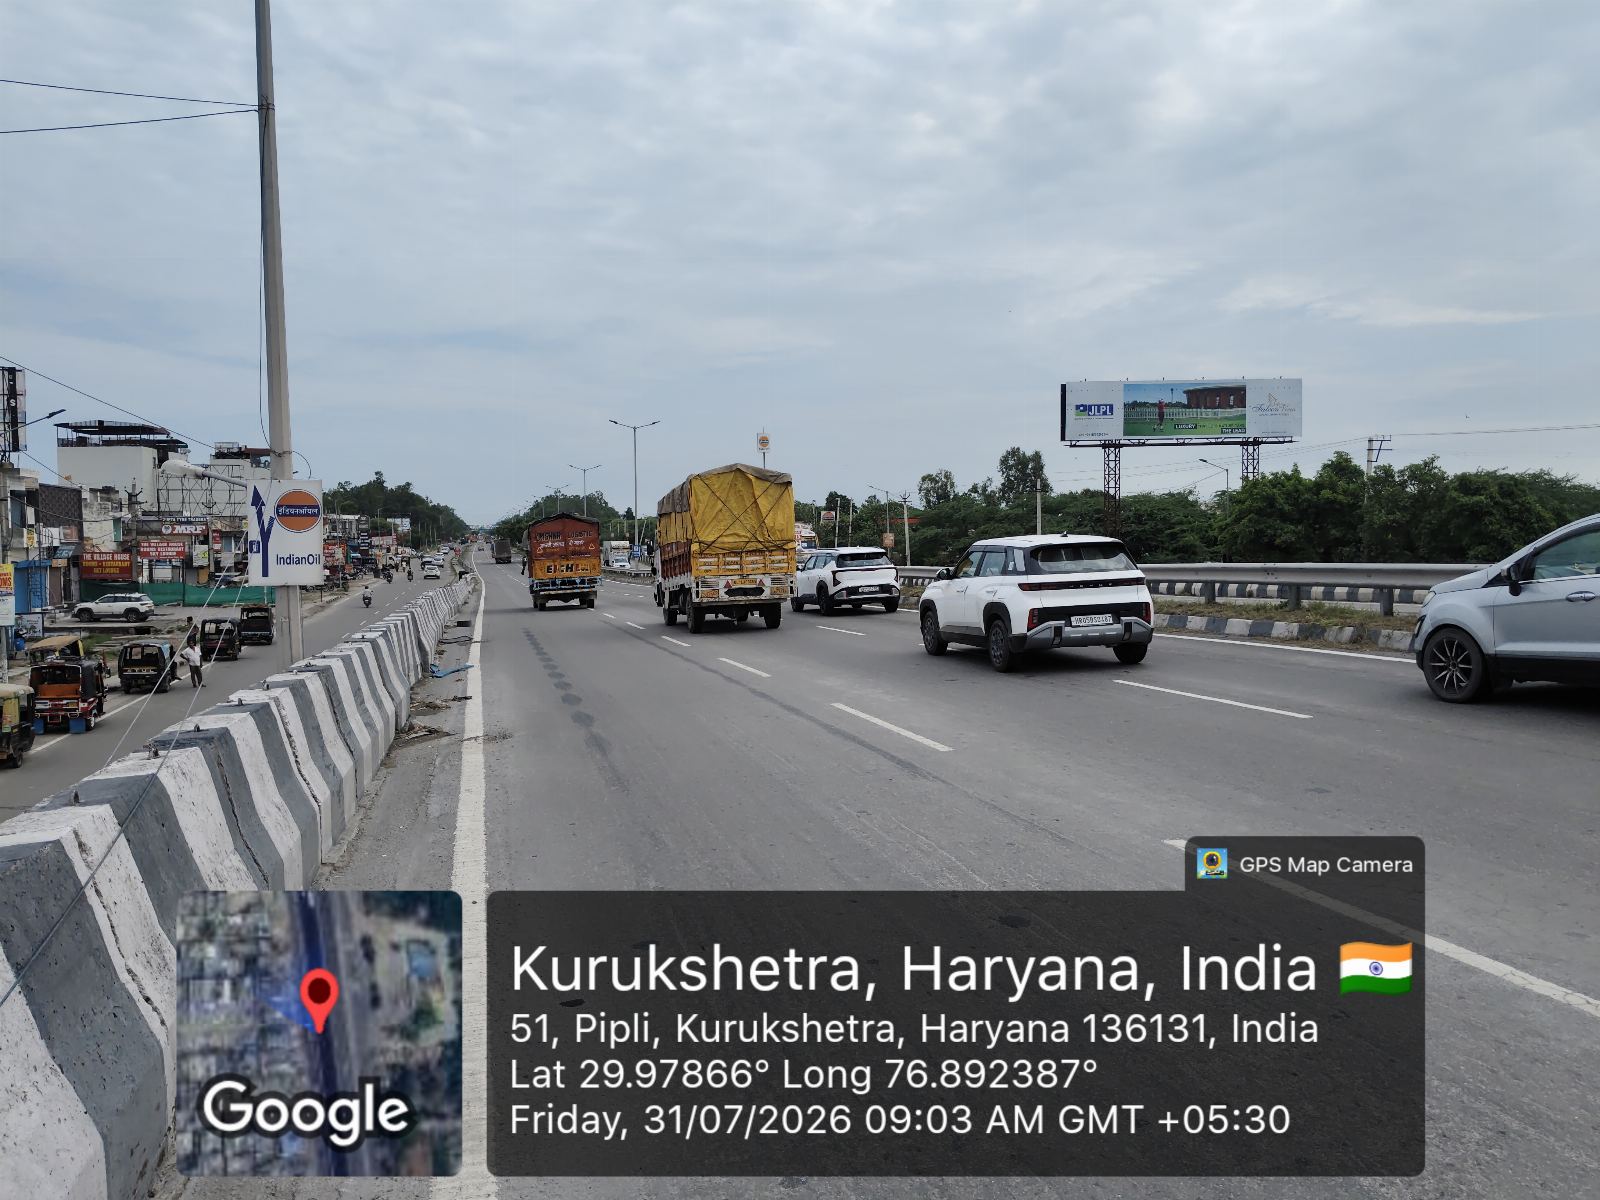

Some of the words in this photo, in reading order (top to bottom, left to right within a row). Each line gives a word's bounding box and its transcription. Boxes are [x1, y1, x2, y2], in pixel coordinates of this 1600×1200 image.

[1089, 405, 1112, 416] JLPL
[173, 525, 206, 534] MRF
[276, 553, 321, 566] IndianOil
